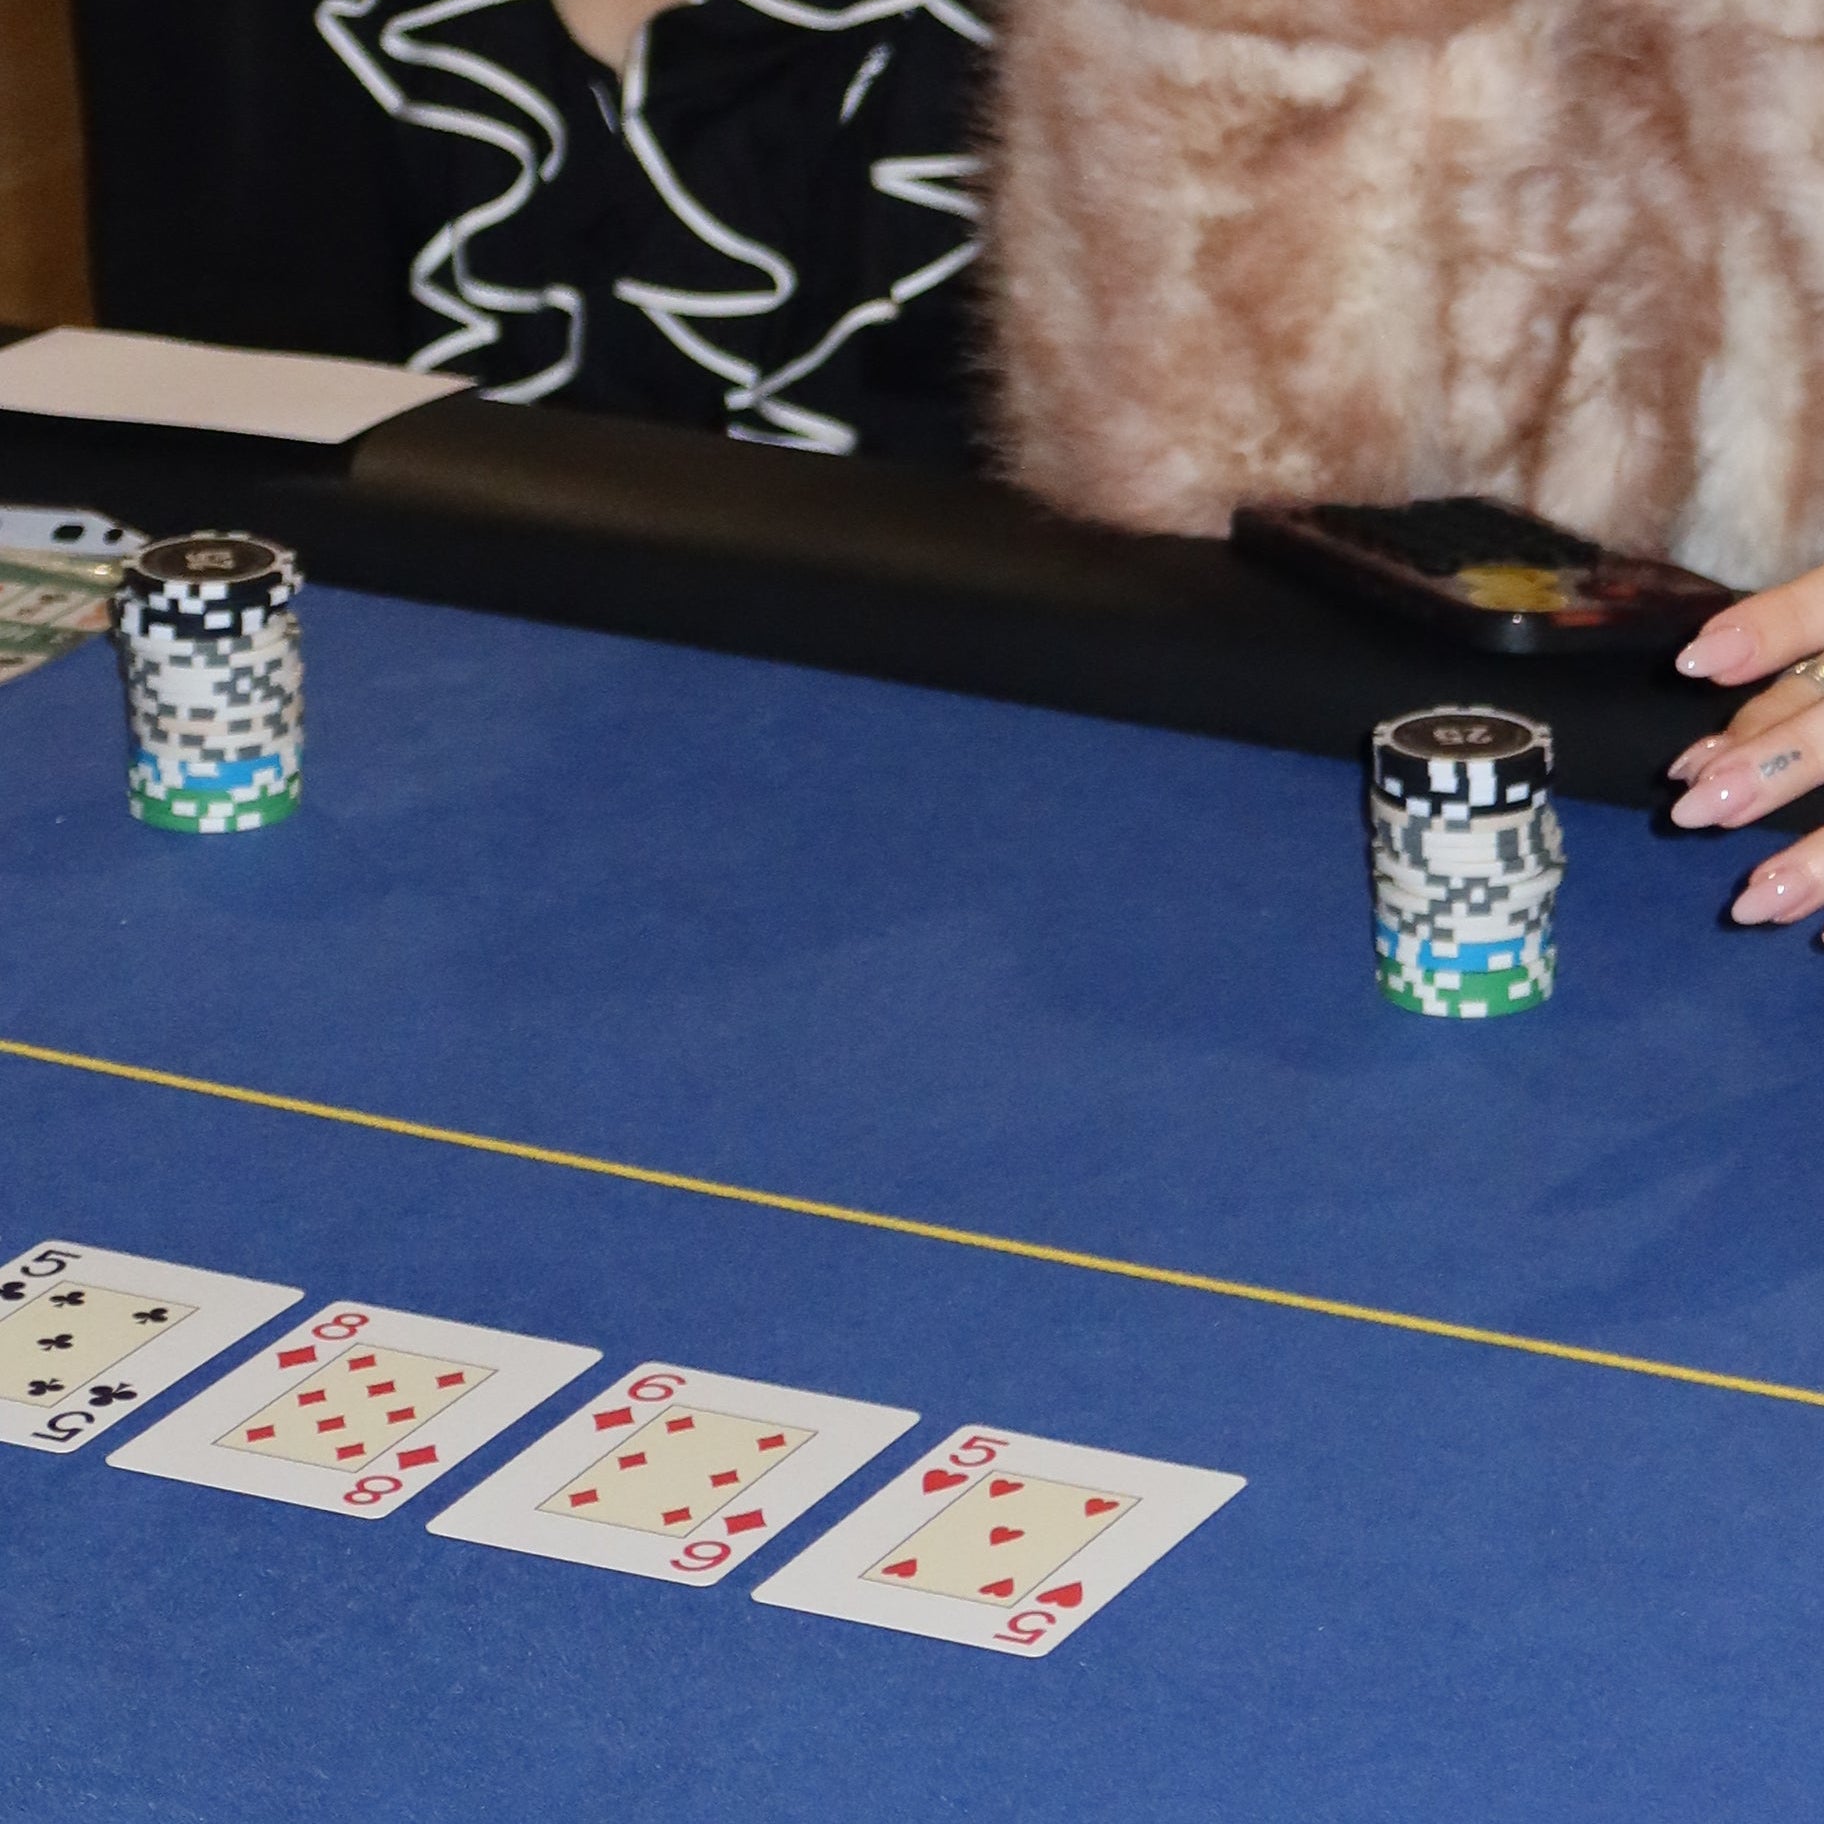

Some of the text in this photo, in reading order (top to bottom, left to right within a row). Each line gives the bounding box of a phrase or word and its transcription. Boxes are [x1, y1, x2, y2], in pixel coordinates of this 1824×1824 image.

[21, 1250, 81, 1278] 5
[312, 1312, 369, 1341] 8
[627, 1374, 687, 1402] 6
[32, 1410, 95, 1443] 5
[949, 1435, 1010, 1467] 5
[342, 1475, 403, 1505] 8
[671, 1540, 731, 1572] 6
[994, 1610, 1057, 1645] 5
